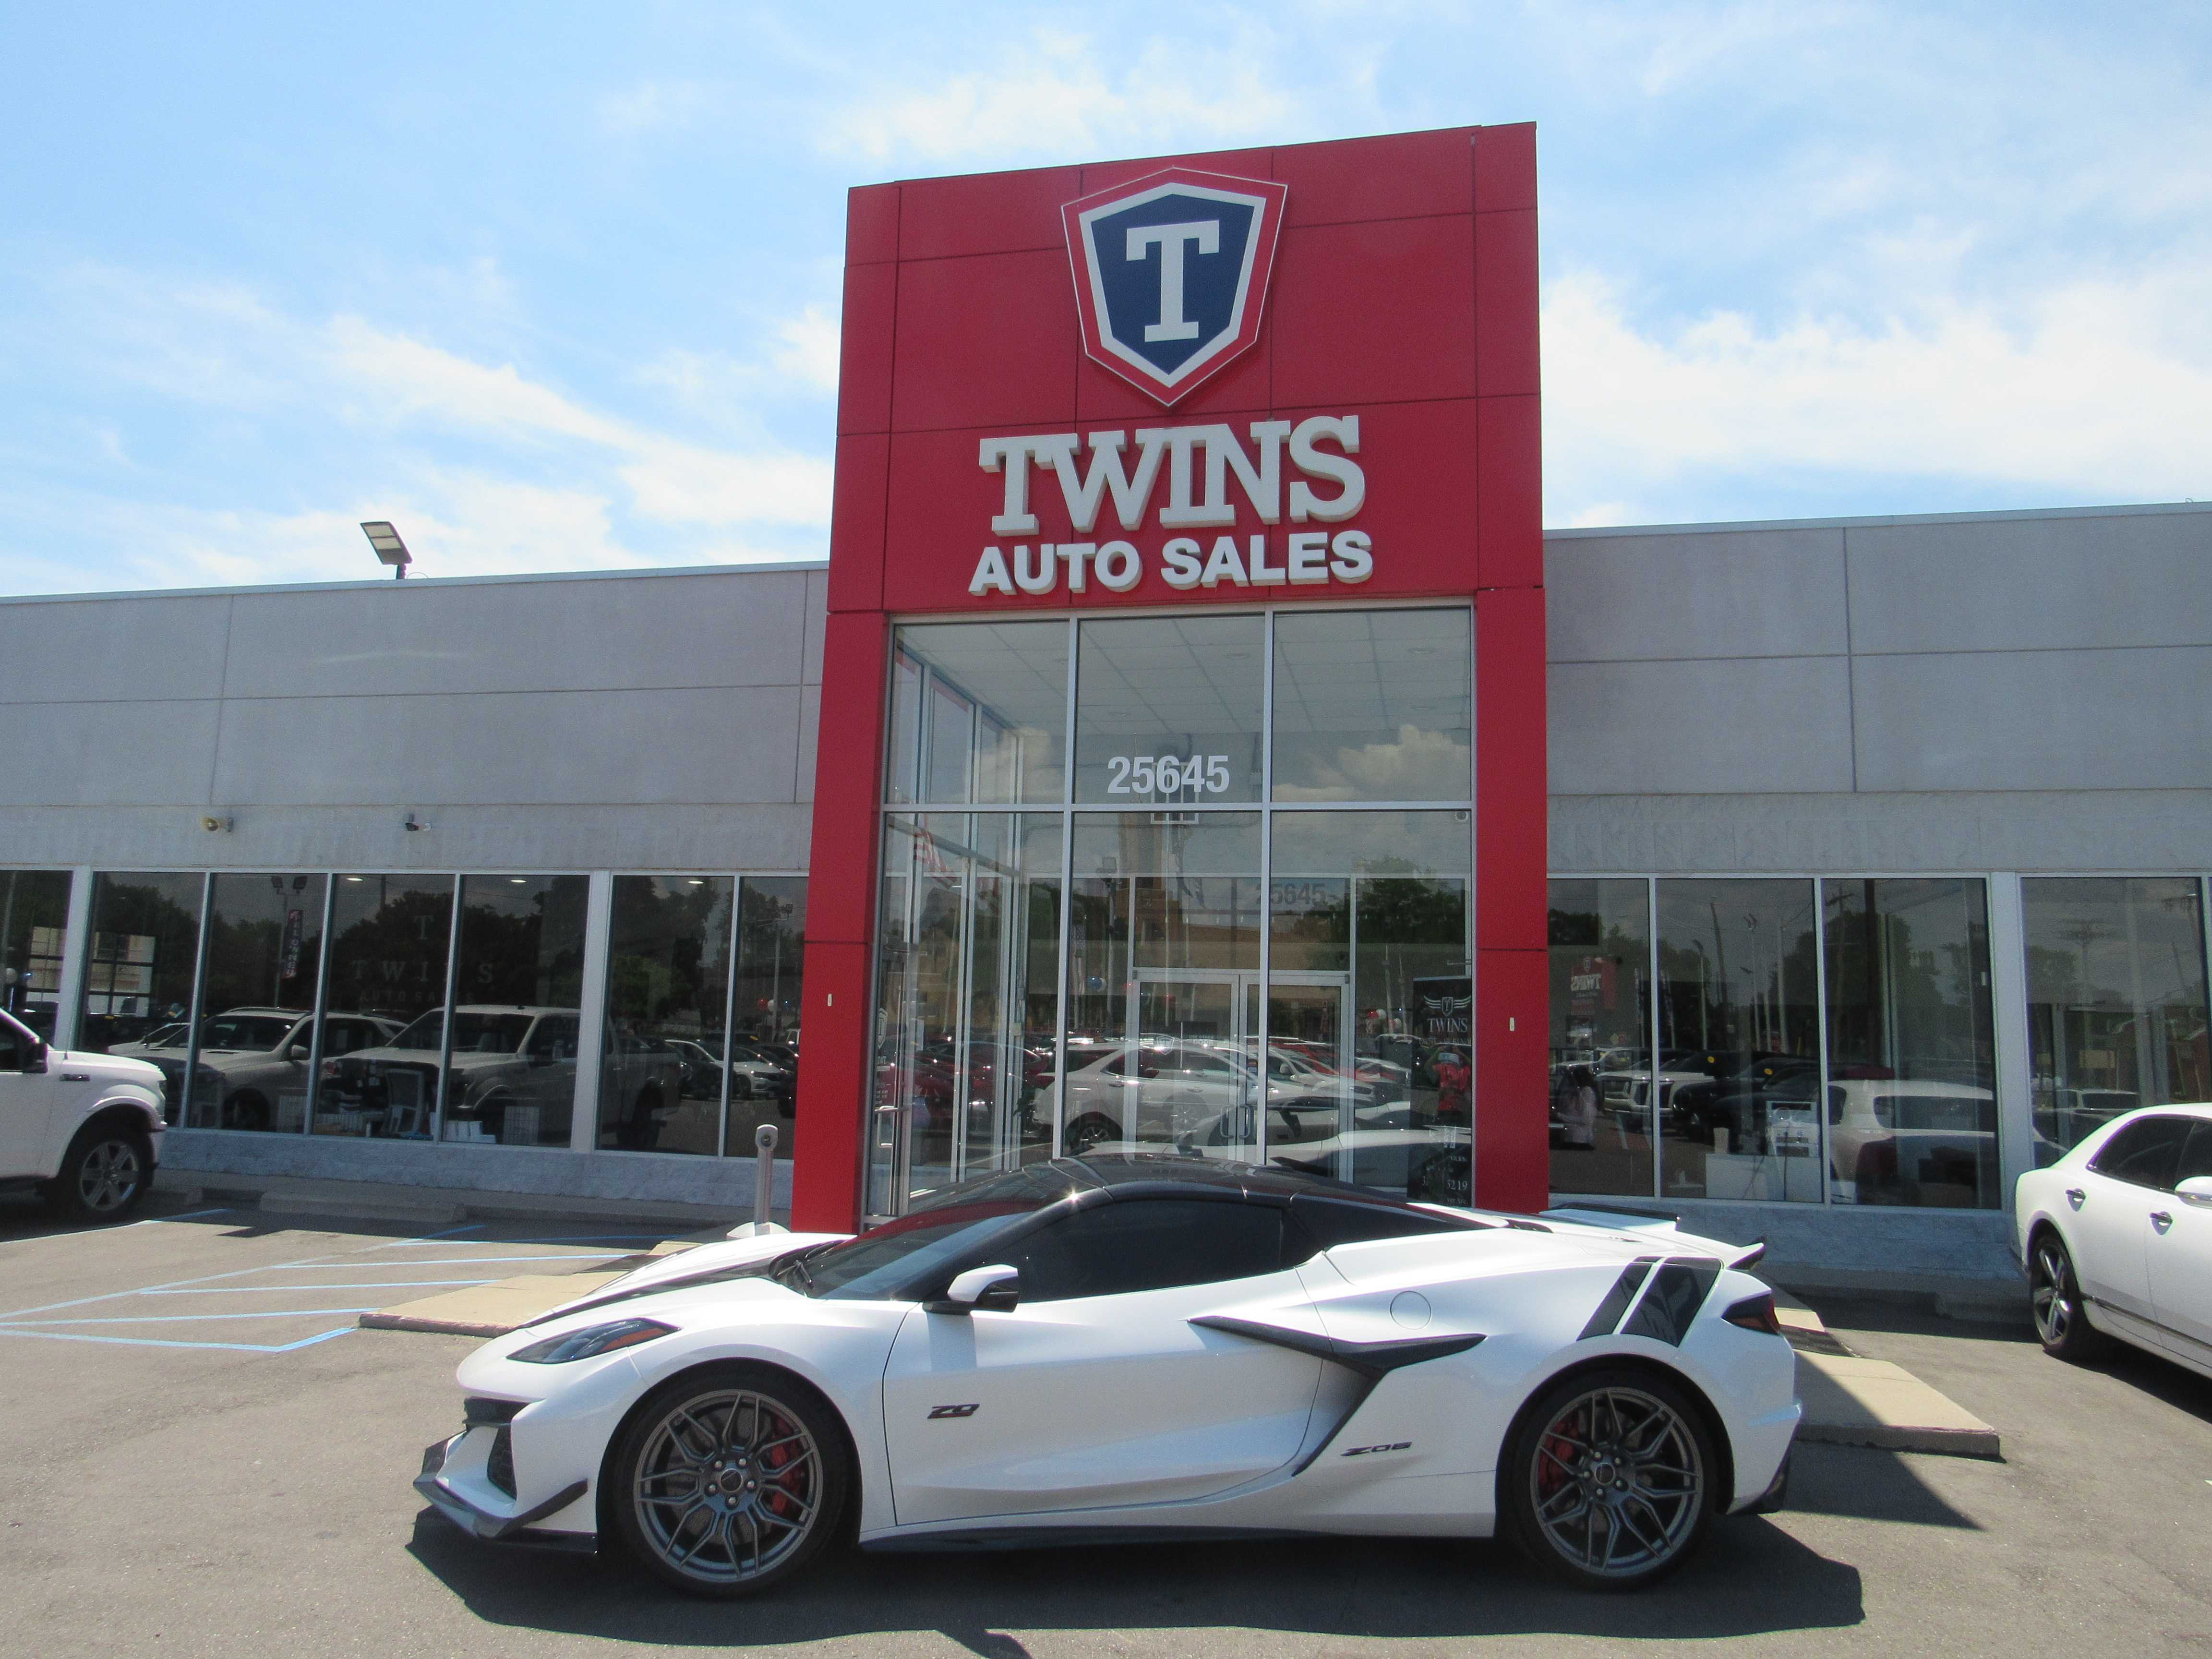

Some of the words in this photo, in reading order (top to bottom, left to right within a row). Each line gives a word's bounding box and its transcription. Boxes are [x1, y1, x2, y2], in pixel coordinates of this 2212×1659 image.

[1126, 220, 1219, 342] T
[979, 415, 1365, 536] TWINS
[968, 541, 1142, 596] AUTO
[1161, 530, 1373, 590] SALES
[1107, 755, 1230, 793] 25645
[350, 960, 494, 984] TWIS
[1427, 1018, 1468, 1033] TWINS
